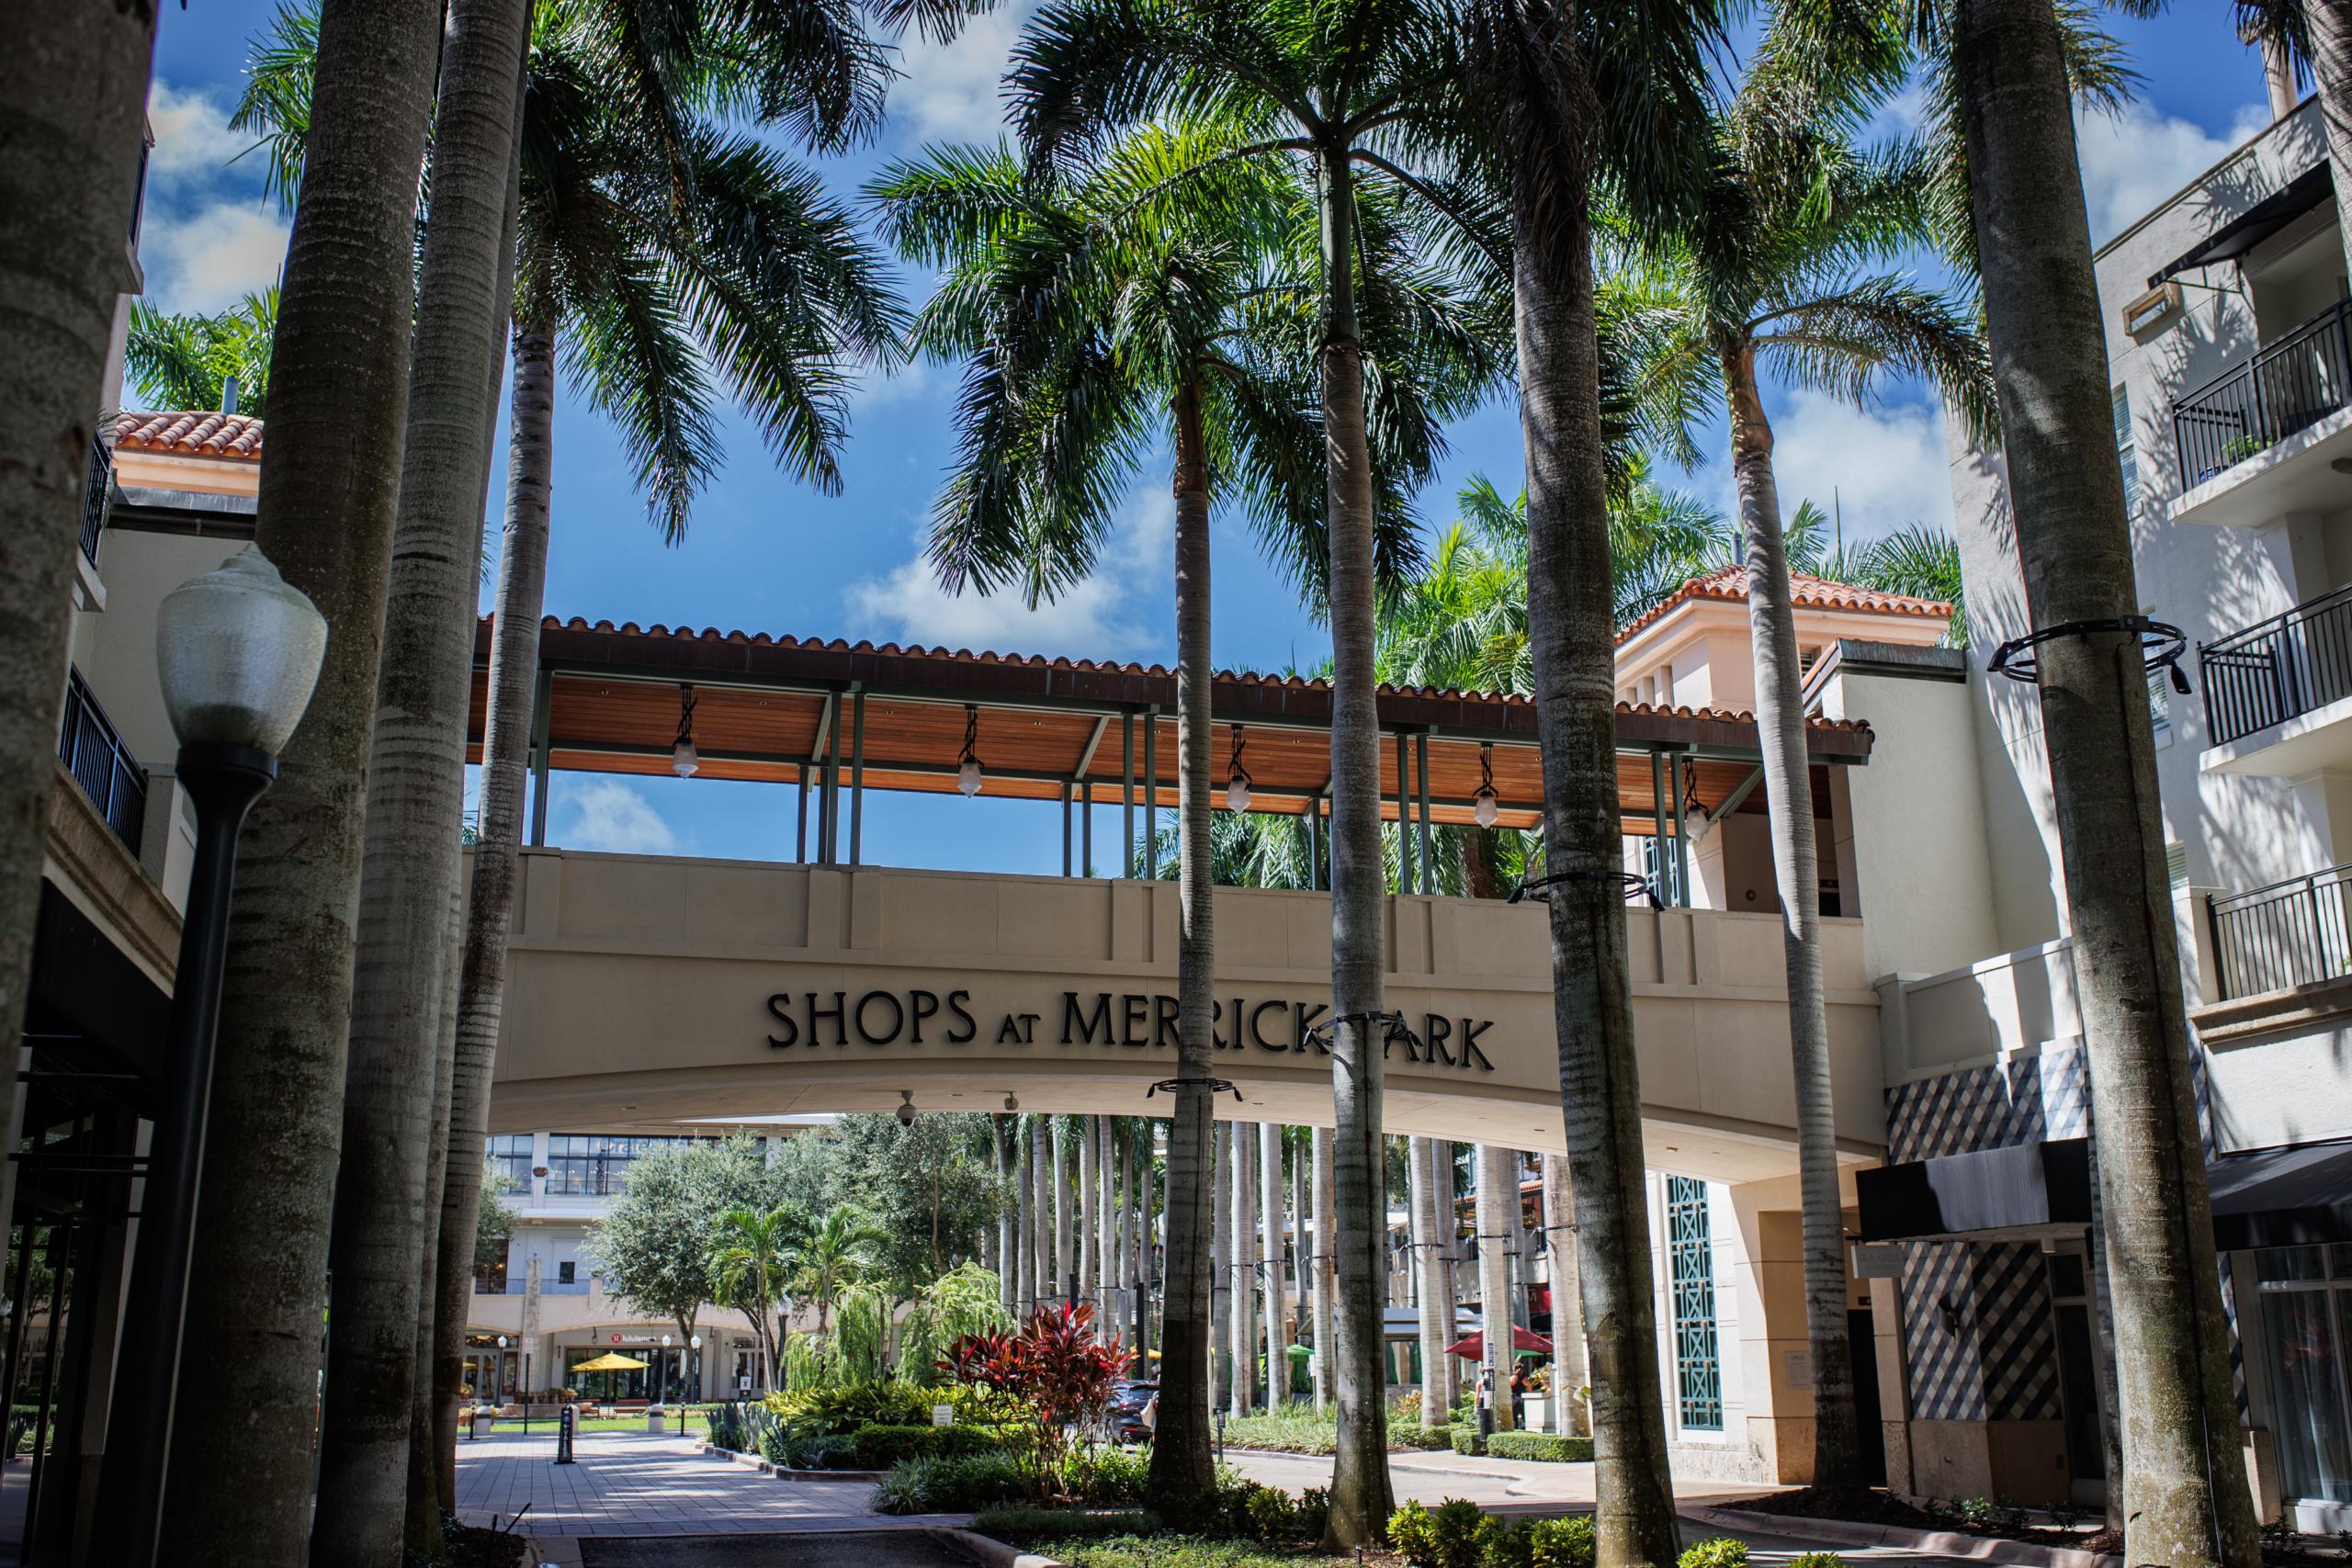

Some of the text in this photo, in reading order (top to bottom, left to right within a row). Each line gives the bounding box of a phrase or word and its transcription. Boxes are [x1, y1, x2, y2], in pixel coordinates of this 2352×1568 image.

[767, 989, 978, 1049] SHOPS
[997, 1013, 1042, 1043] AT
[1381, 1009, 1496, 1072] ARK
[1858, 1253, 1902, 1263] SEA GRILL
